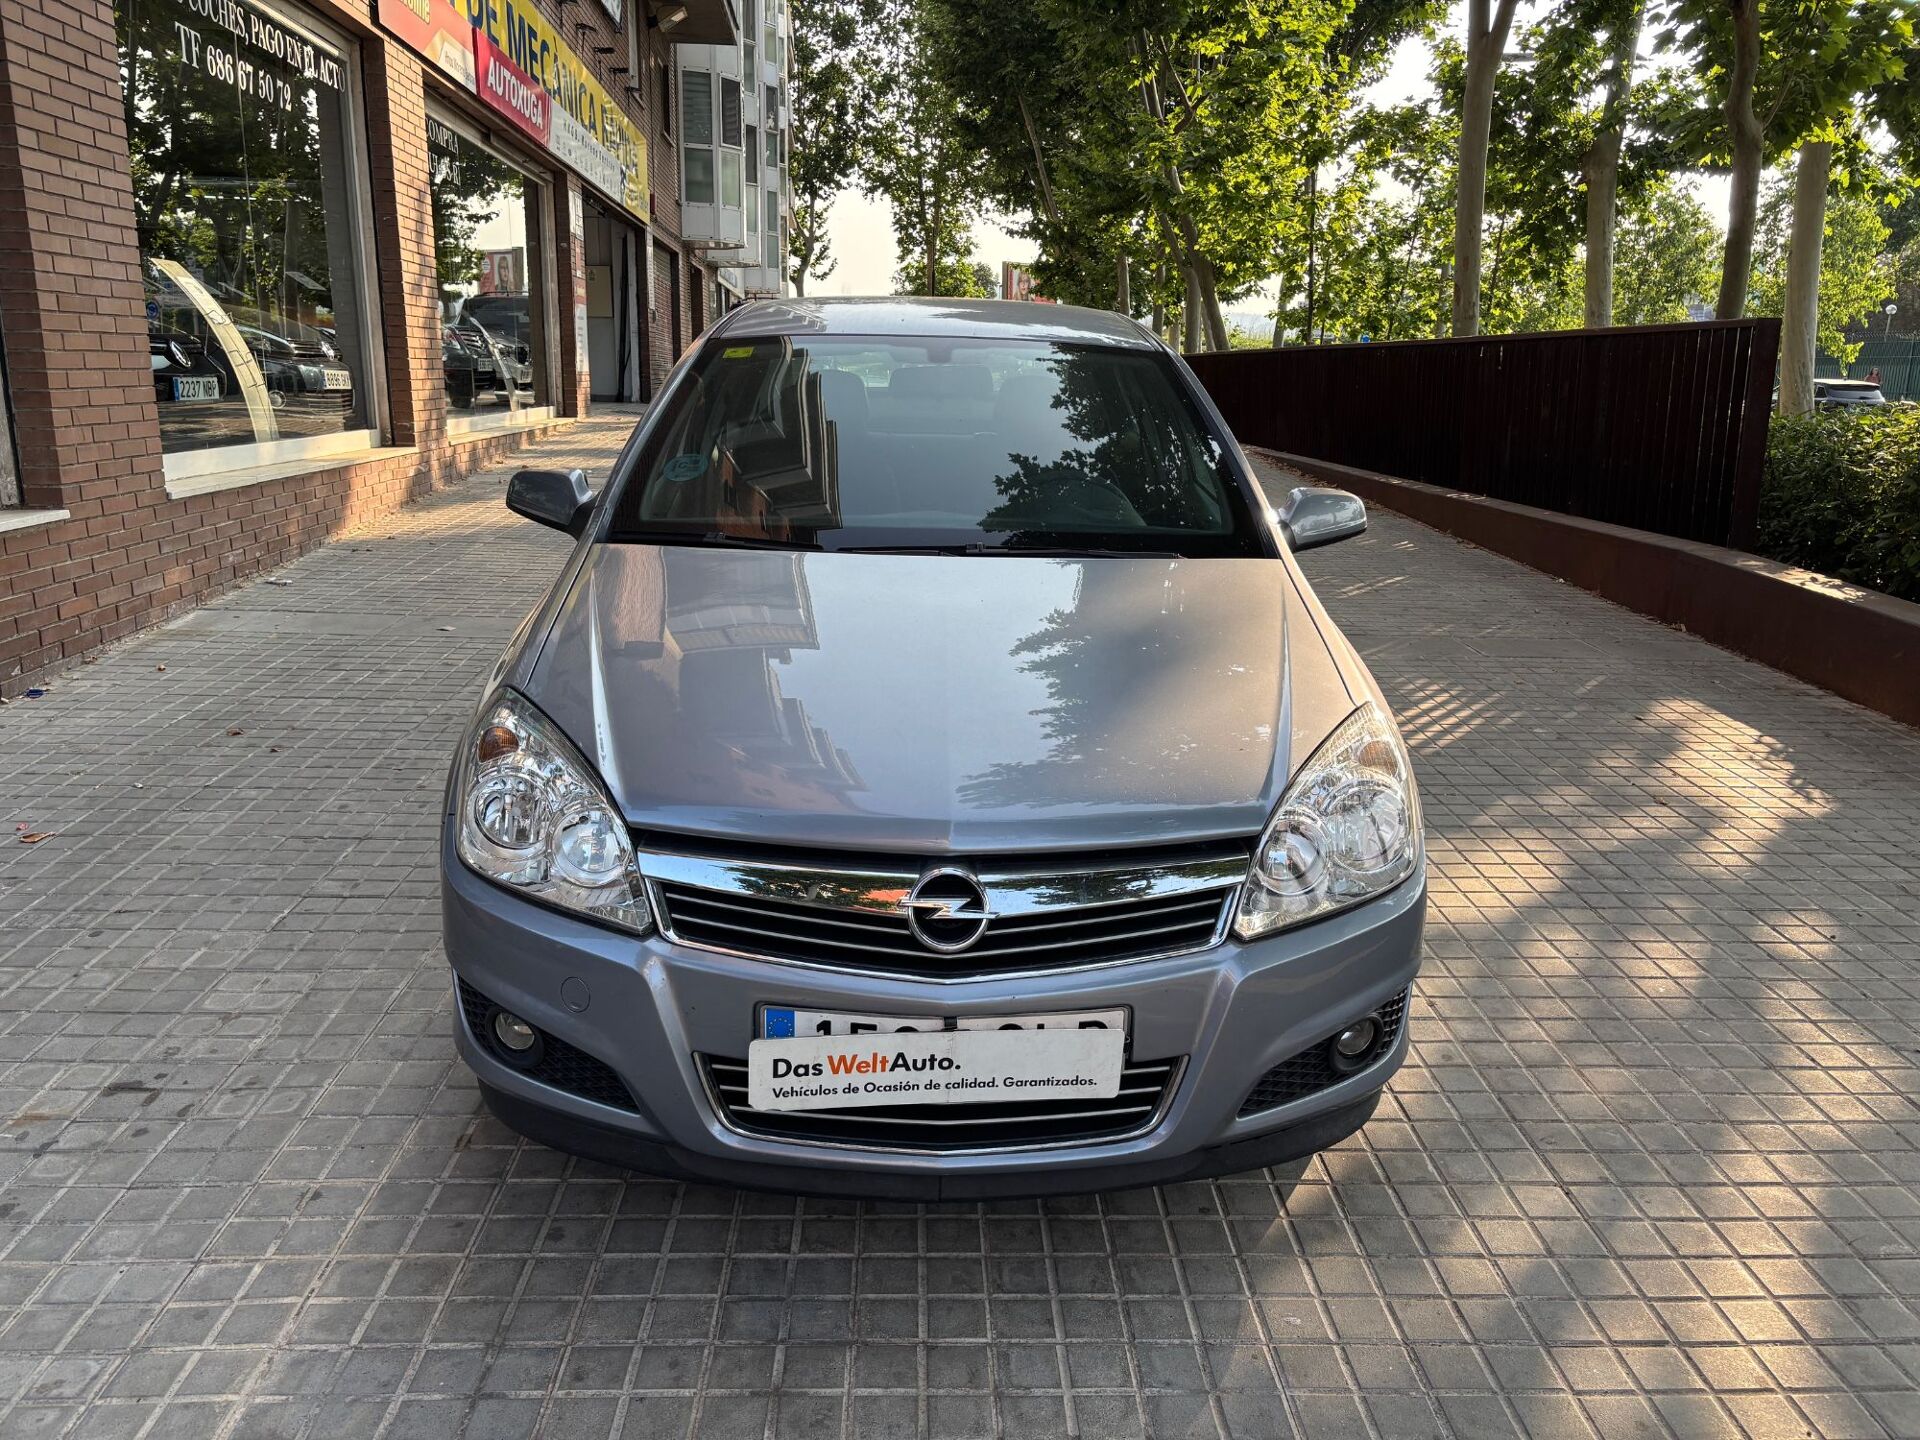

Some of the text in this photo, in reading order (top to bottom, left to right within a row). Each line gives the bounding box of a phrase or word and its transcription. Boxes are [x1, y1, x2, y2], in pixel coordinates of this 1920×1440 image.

[175, 20, 292, 112] TF 686 67 50 72
[250, 13, 283, 58] PAGO
[285, 34, 302, 70] EN
[320, 55, 346, 92] ACTO
[487, 56, 543, 130] AUTOXUGA
[425, 117, 459, 155] OMPRA
[180, 380, 200, 398] 2237
[772, 1051, 961, 1079] Das WeltAuto.
[773, 1075, 1098, 1098] Vehículos de Ocasión de calidad. Garantizados.
